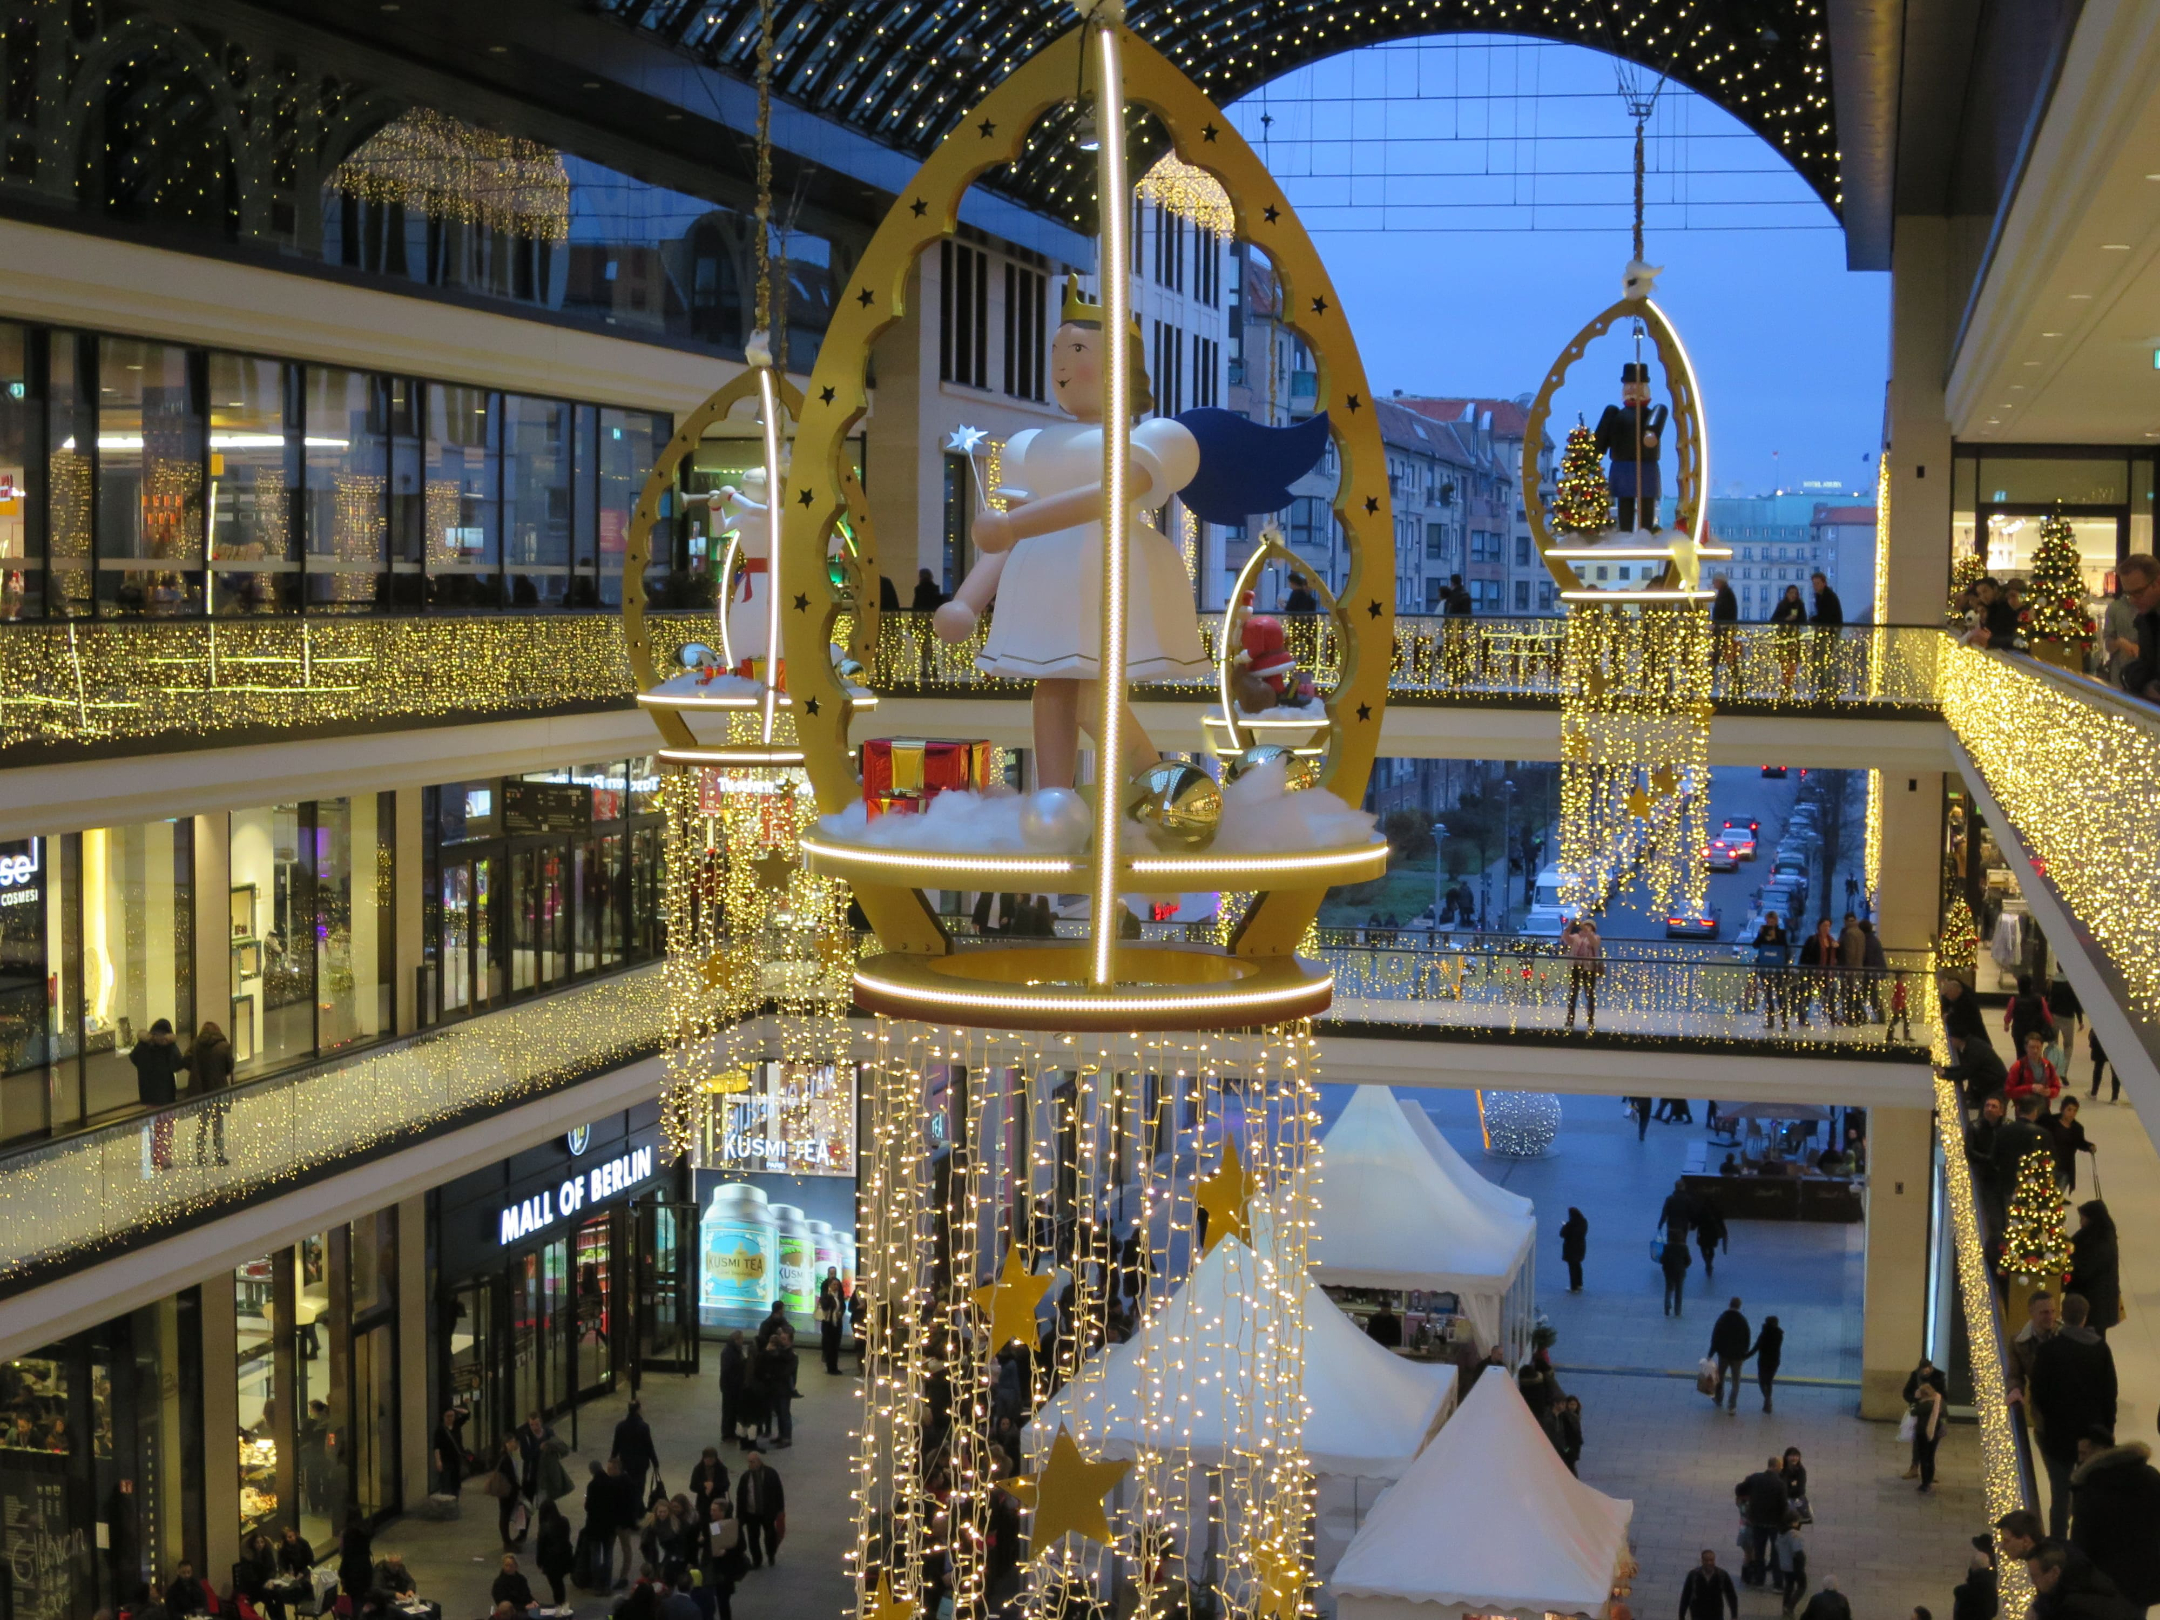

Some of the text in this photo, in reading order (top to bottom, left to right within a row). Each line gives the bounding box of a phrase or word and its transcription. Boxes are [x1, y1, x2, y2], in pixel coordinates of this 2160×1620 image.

[1, 888, 38, 907] COSMESI
[723, 1134, 830, 1167] KUSMI TEA
[766, 1161, 786, 1170] PARIS
[500, 1145, 652, 1245] MALL OF BERLIN
[708, 1255, 740, 1269] KUSMI
[743, 1257, 763, 1273] TEA
